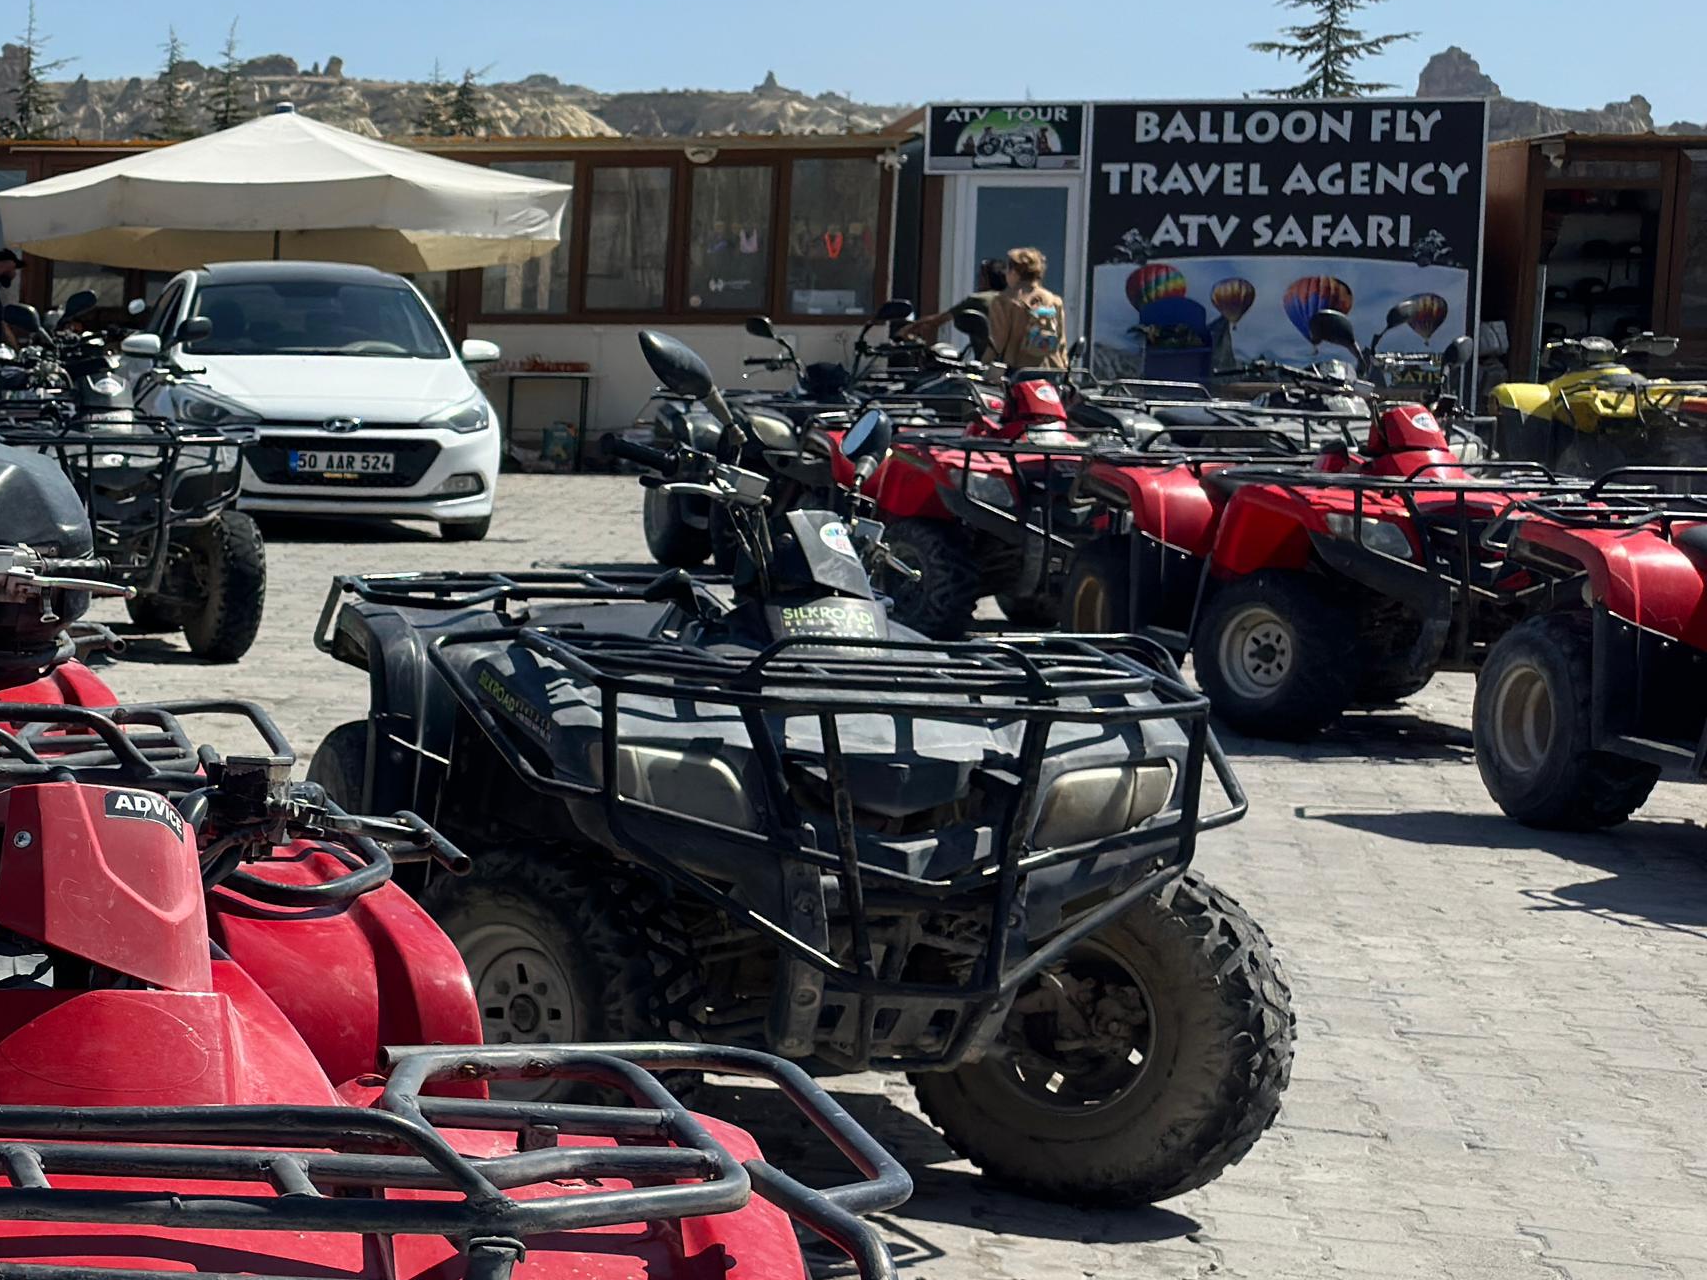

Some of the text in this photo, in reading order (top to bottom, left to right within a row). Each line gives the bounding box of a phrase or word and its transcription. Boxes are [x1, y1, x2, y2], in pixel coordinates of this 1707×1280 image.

[945, 106, 1068, 123] ATV TOUR
[1135, 108, 1441, 144] BALLOON FLY
[1102, 161, 1469, 197] TRAVEL AGENCY
[1151, 214, 1411, 248] ATV SAFARI
[299, 453, 391, 470] 50 AAR 524
[782, 605, 872, 625] SILKROAD
[113, 792, 185, 835] ADVICE
